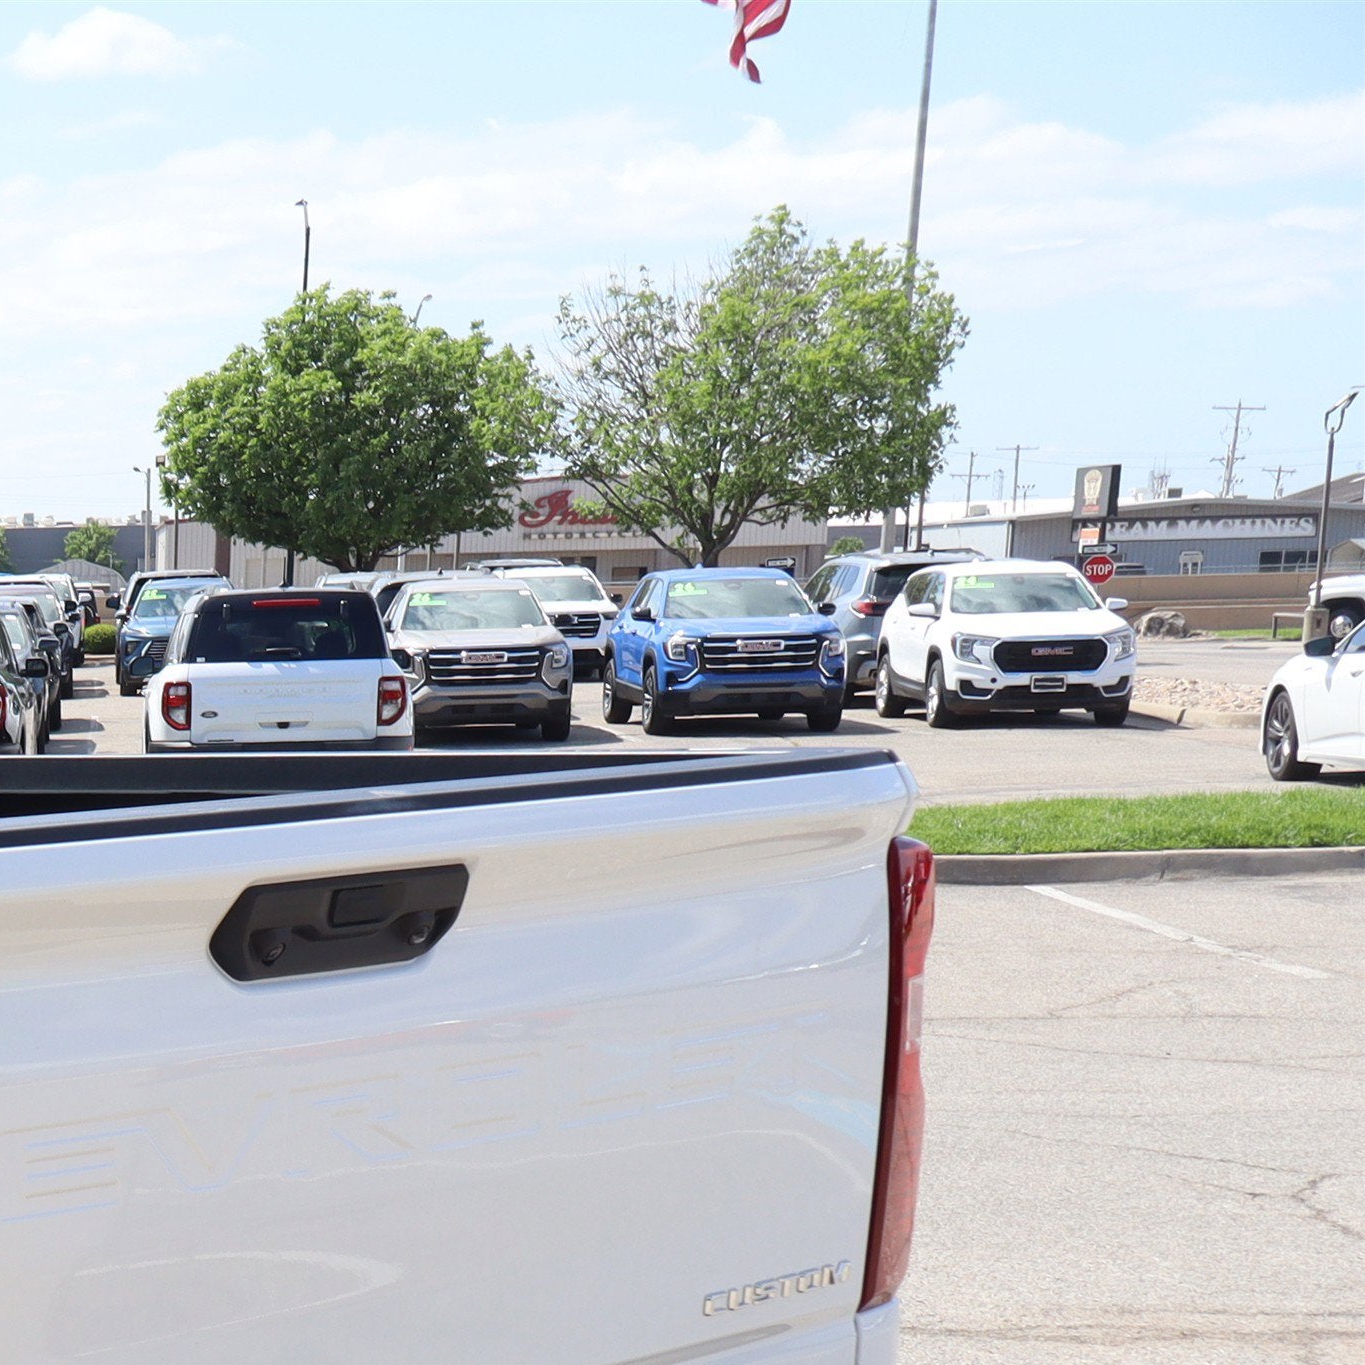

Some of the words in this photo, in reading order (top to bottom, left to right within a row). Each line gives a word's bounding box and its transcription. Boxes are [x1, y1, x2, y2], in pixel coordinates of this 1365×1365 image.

[1177, 517, 1314, 536] MACHINES
[1085, 564, 1112, 576] STOP
[703, 1259, 851, 1316] CUSTOM
